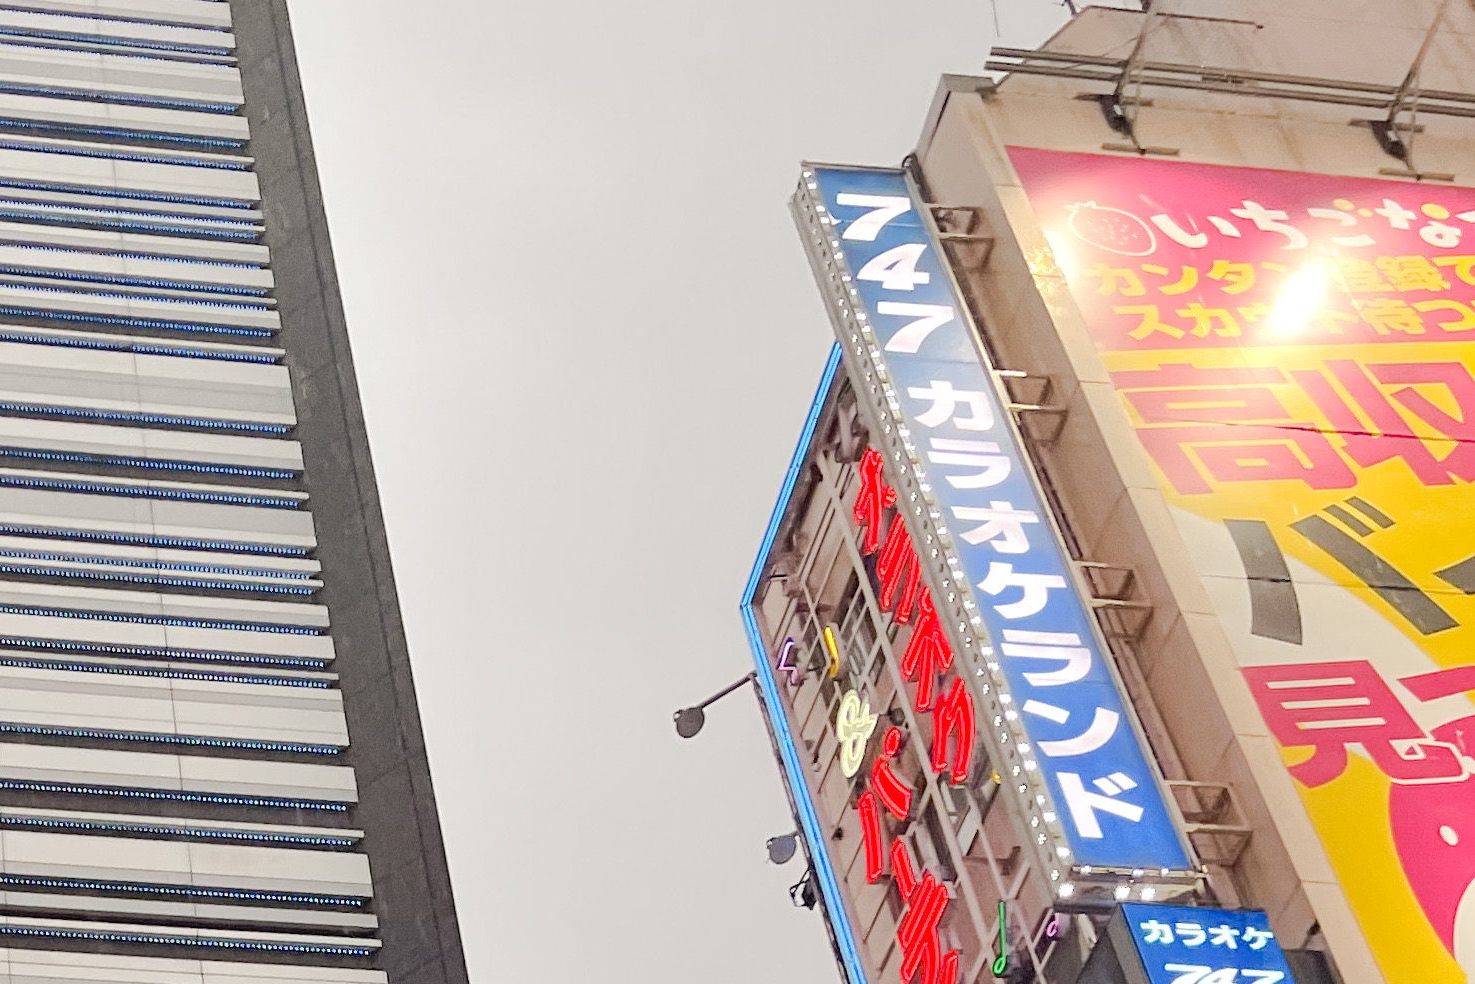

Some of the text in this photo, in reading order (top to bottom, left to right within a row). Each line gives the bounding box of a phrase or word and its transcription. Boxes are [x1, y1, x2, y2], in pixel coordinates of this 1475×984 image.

[1149, 198, 1475, 251] いちごな
[836, 193, 1146, 840] 747 カラオケランド
[1139, 919, 1275, 951] カラオケ
